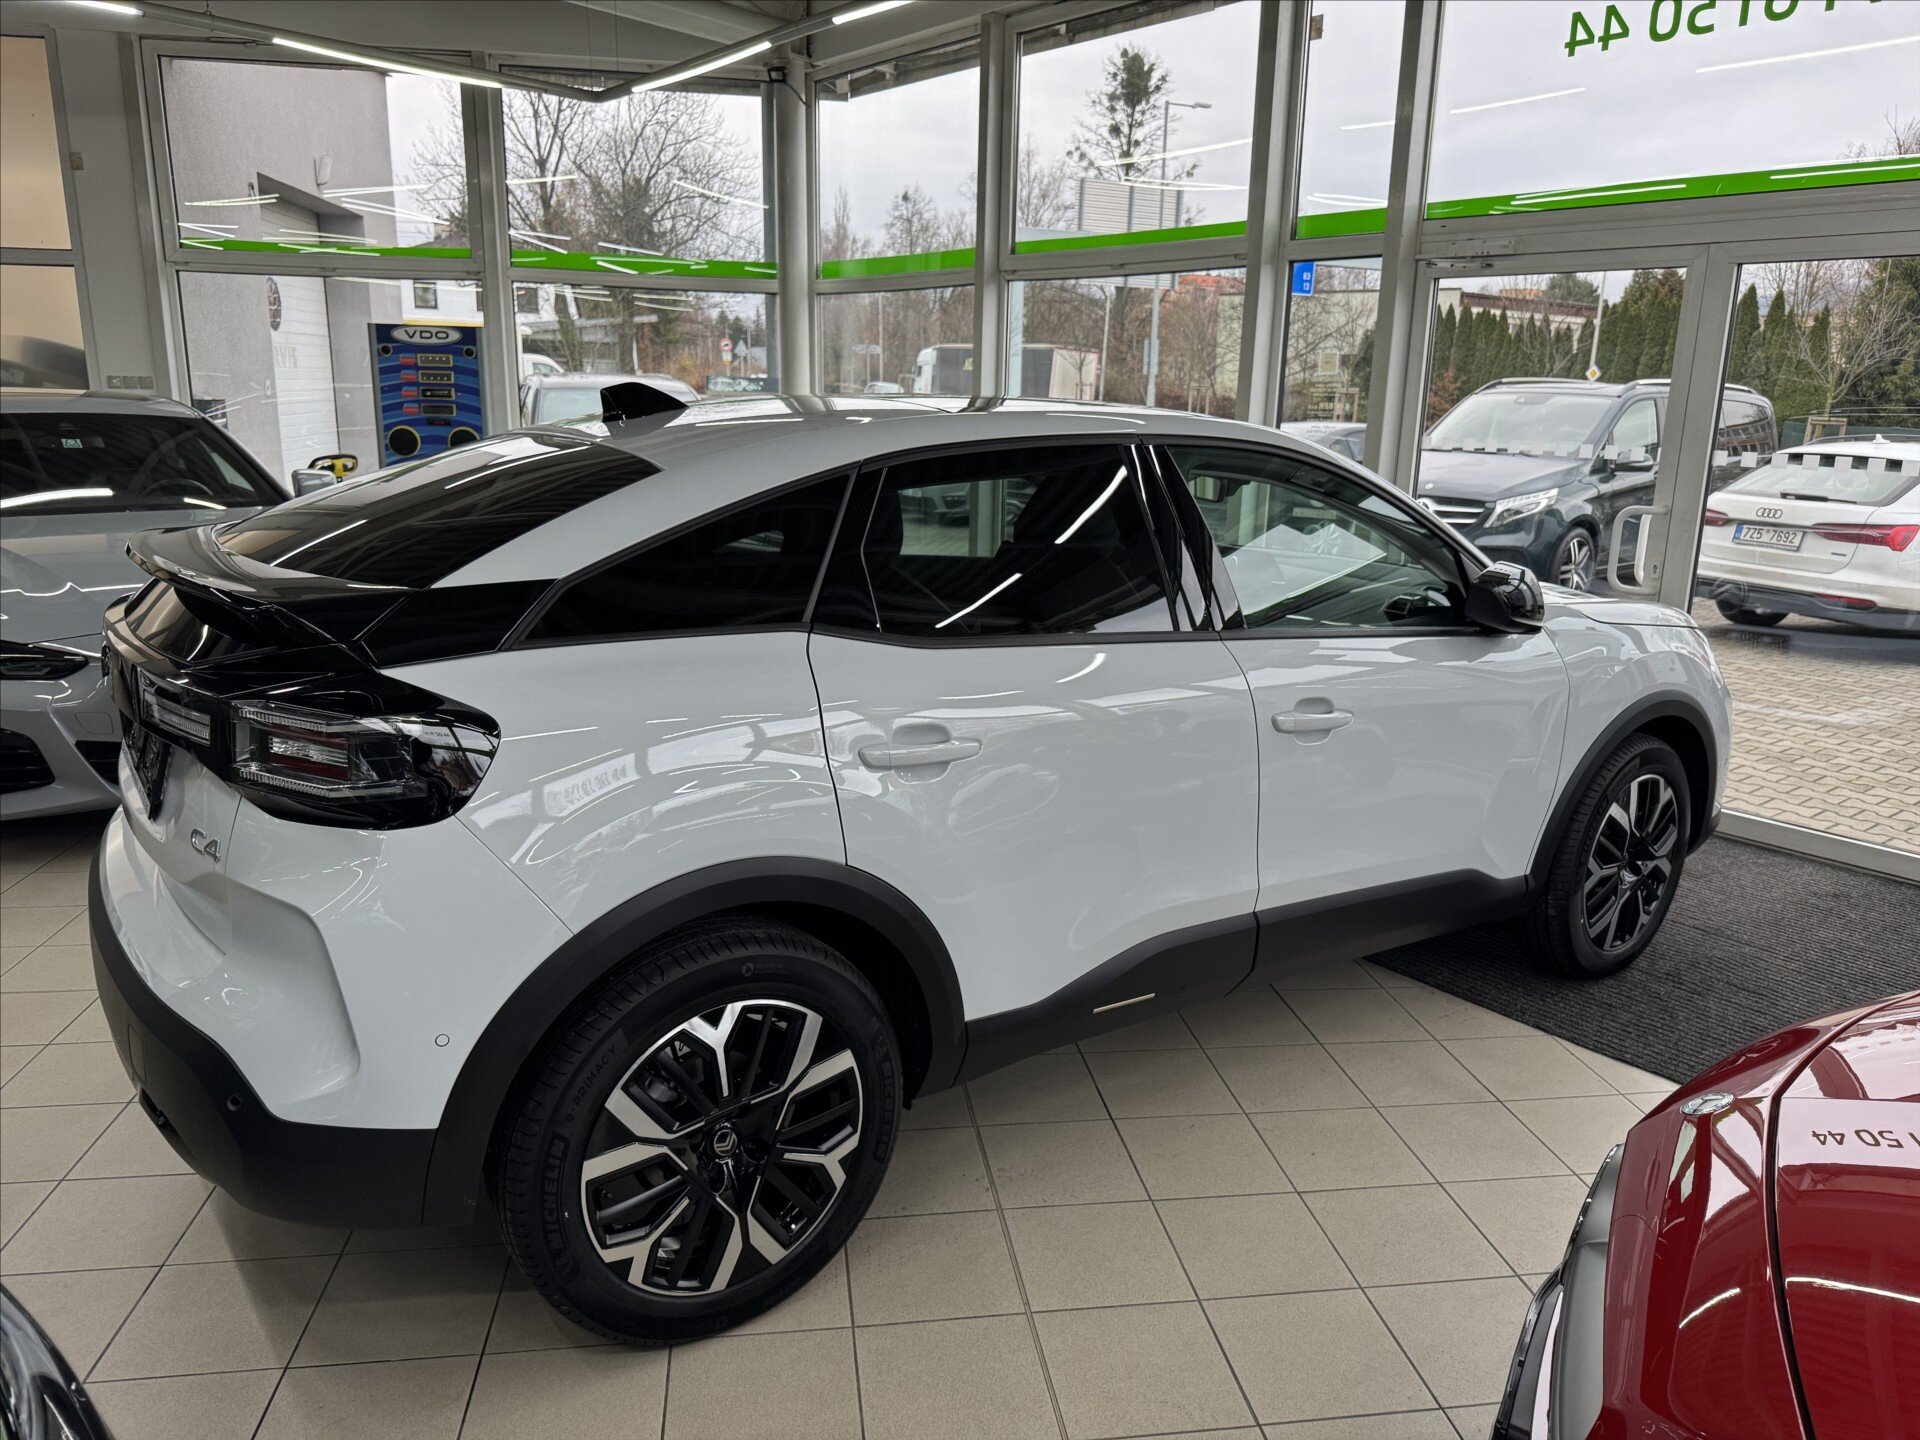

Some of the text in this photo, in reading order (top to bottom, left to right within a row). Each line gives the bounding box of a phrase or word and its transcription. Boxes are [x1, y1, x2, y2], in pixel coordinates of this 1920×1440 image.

[404, 329, 449, 340] VDO
[1743, 527, 1797, 544] 7Z5 7692
[191, 828, 221, 863] C4
[1810, 1130, 1845, 1146] 44
[543, 1138, 565, 1250] MICHELIN
